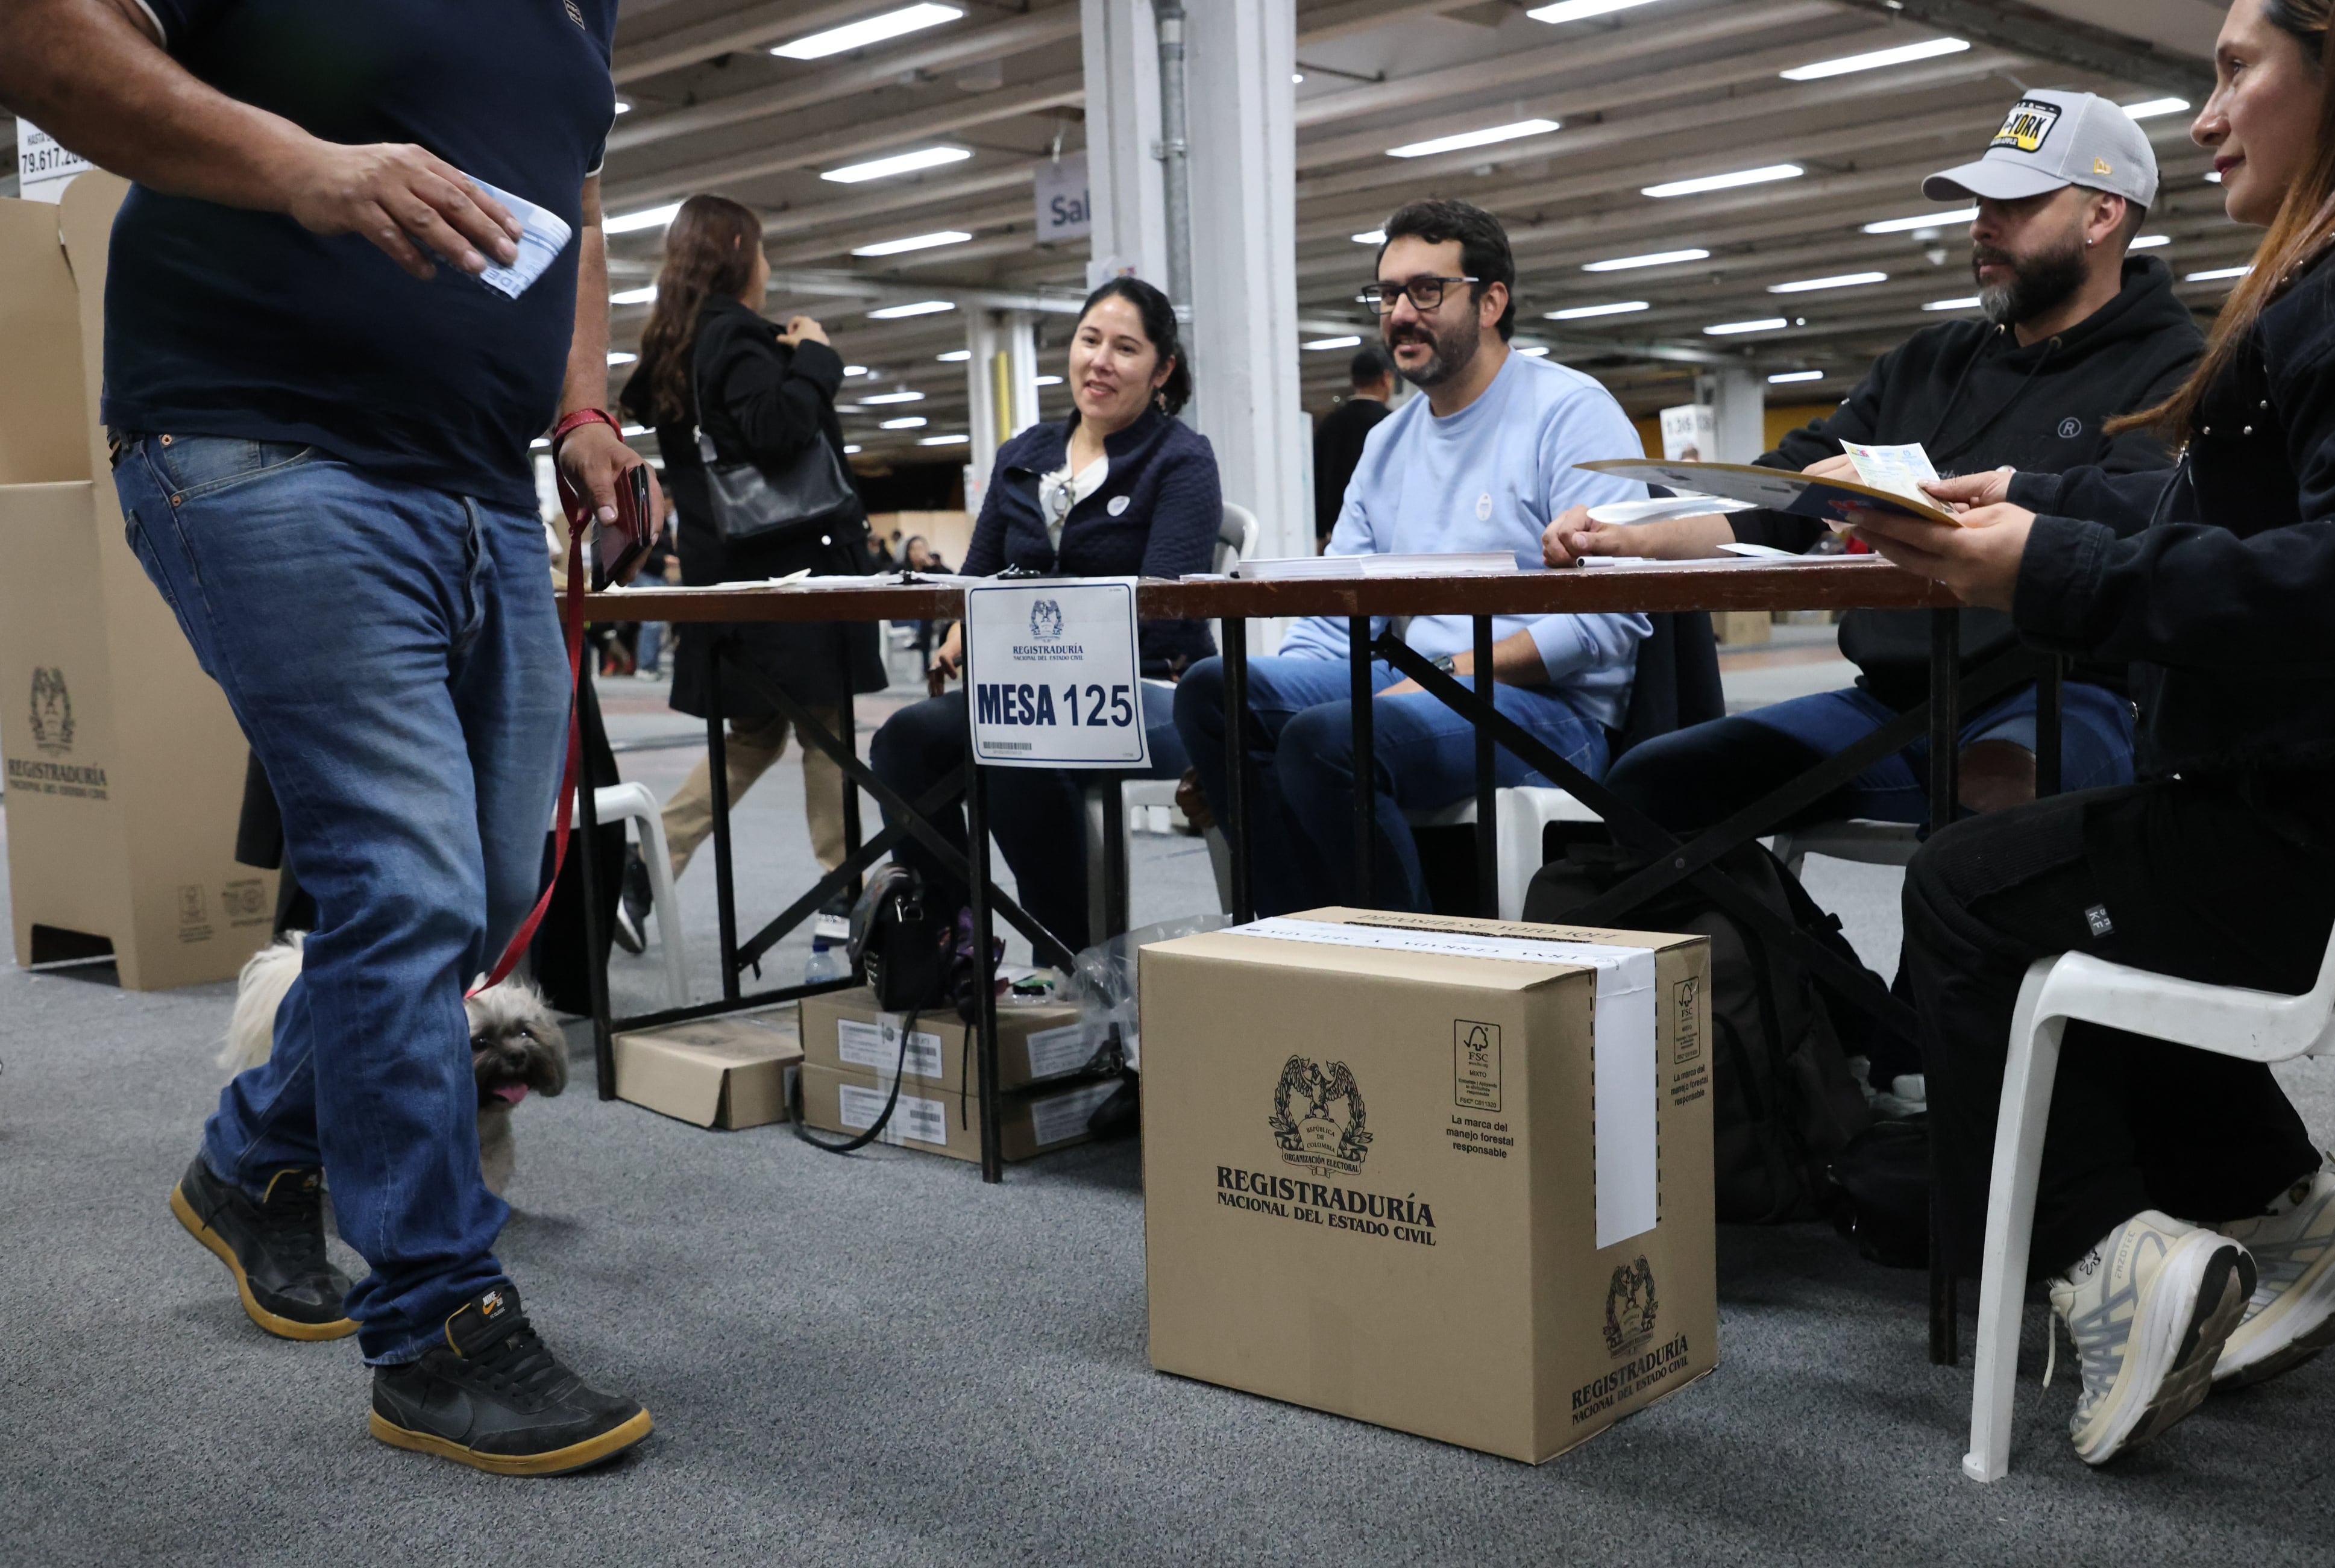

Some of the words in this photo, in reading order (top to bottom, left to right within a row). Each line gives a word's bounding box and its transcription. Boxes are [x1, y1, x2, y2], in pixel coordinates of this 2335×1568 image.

[2008, 113, 2047, 139] YORK
[1013, 642, 1084, 654] REGISTRADURÍA
[977, 683, 1057, 726] MESA
[1063, 684, 1133, 727] 125
[1498, 926, 1557, 934] VOTO
[1682, 1008, 1693, 1017] FSC
[1468, 1051, 1489, 1062] FSC
[1469, 1070, 1487, 1078] MIXTO
[1681, 1069, 1697, 1079] marca
[1697, 1064, 1705, 1074] del
[1671, 1083, 1688, 1096] manejo
[1689, 1075, 1708, 1089] forestal
[1475, 1099, 1497, 1108] C011320
[1674, 1088, 1705, 1106] responsable
[1306, 1124, 1335, 1137] REPÚBLICA
[1452, 1114, 1462, 1124] La
[1465, 1118, 1492, 1129] marca
[1494, 1122, 1507, 1132] del
[1447, 1128, 1479, 1141] manejo
[1480, 1133, 1513, 1146] forestal
[1306, 1142, 1335, 1153] COLOMBIA
[1453, 1142, 1507, 1158] responsable
[1284, 1152, 1325, 1165] ORGANIZACIÓN
[1327, 1158, 1359, 1173] ELECTORAL
[1217, 1165, 1436, 1228] REGISTRADURÍA
[1218, 1191, 1289, 1218] NACIONAL
[1294, 1206, 1324, 1225] DEL
[1328, 1213, 1389, 1237] ESTADO
[1394, 1226, 1436, 1246] CIVIL
[482, 1290, 497, 1306] NIKE
[1572, 1332, 1688, 1410] REGISTRADURÍA
[1573, 1394, 1615, 1426] NACIONAL
[1618, 1384, 1634, 1402] DEL
[1636, 1367, 1667, 1391] ESTADO
[1668, 1356, 1689, 1374] CIVIL
